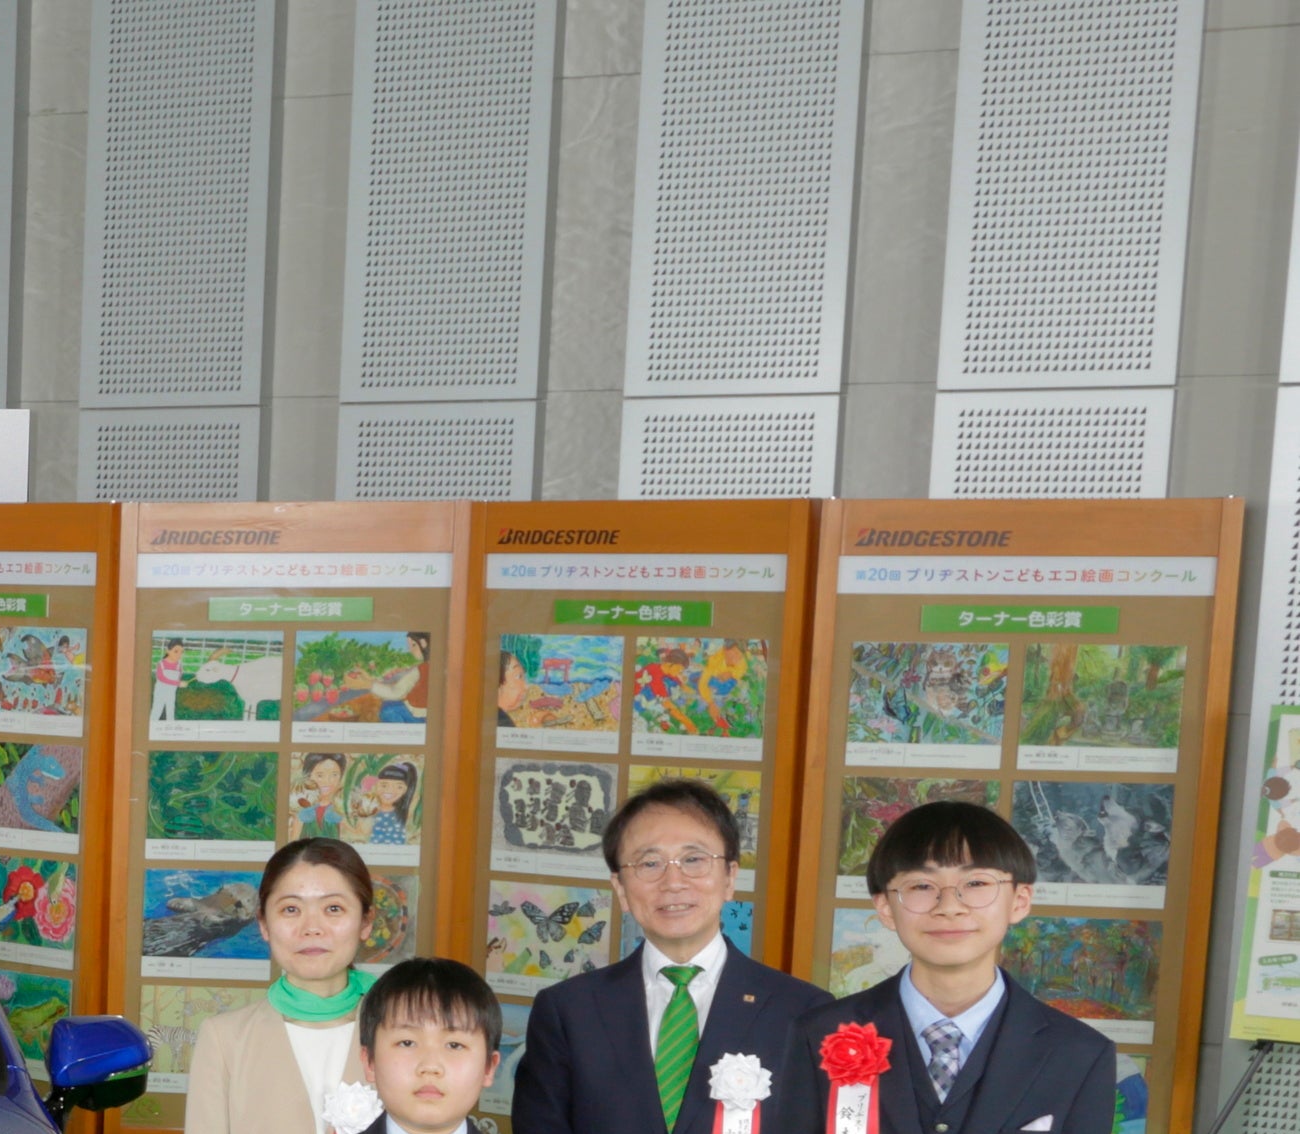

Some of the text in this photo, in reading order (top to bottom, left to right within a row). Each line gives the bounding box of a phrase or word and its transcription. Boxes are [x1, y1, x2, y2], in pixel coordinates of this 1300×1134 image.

[150, 528, 282, 546] BRIDGESTONE
[498, 527, 621, 545] BRIDGESTONE
[854, 527, 1013, 548] BRIDGESTONE
